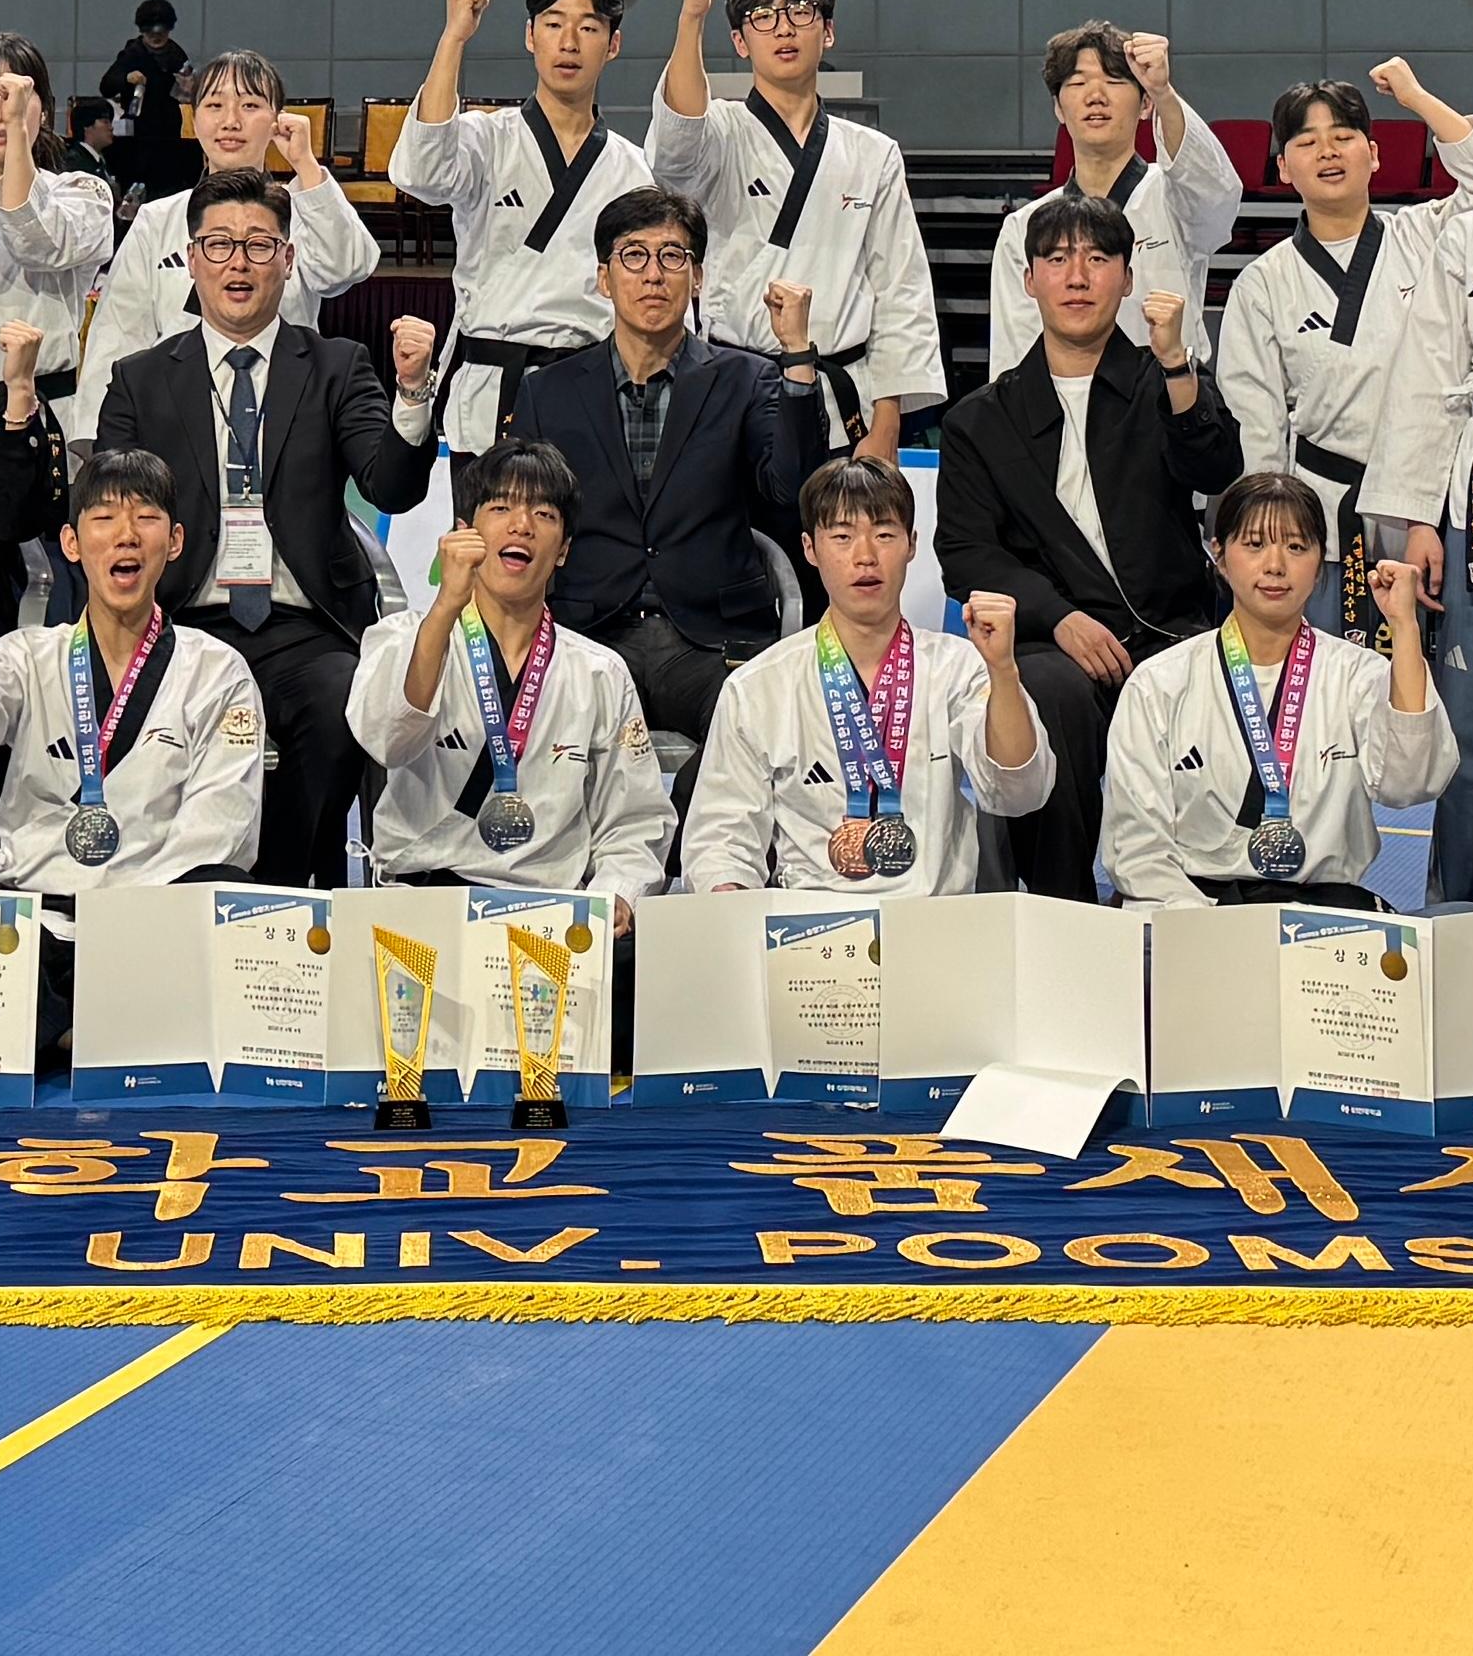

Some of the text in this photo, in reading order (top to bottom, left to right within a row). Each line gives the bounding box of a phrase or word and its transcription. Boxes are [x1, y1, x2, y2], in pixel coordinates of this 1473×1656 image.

[475, 663, 500, 725] 신한대학교
[513, 671, 541, 731] 신한대학교
[845, 688, 879, 752] 신한대학교
[890, 685, 909, 751] 신한대학교
[1241, 691, 1270, 753] 신한대학교
[1279, 691, 1301, 752] 신한대학교
[829, 688, 862, 793] 제5회 신한대학교
[1260, 762, 1280, 794] 제5회
[85, 1226, 662, 1270] UNIV.
